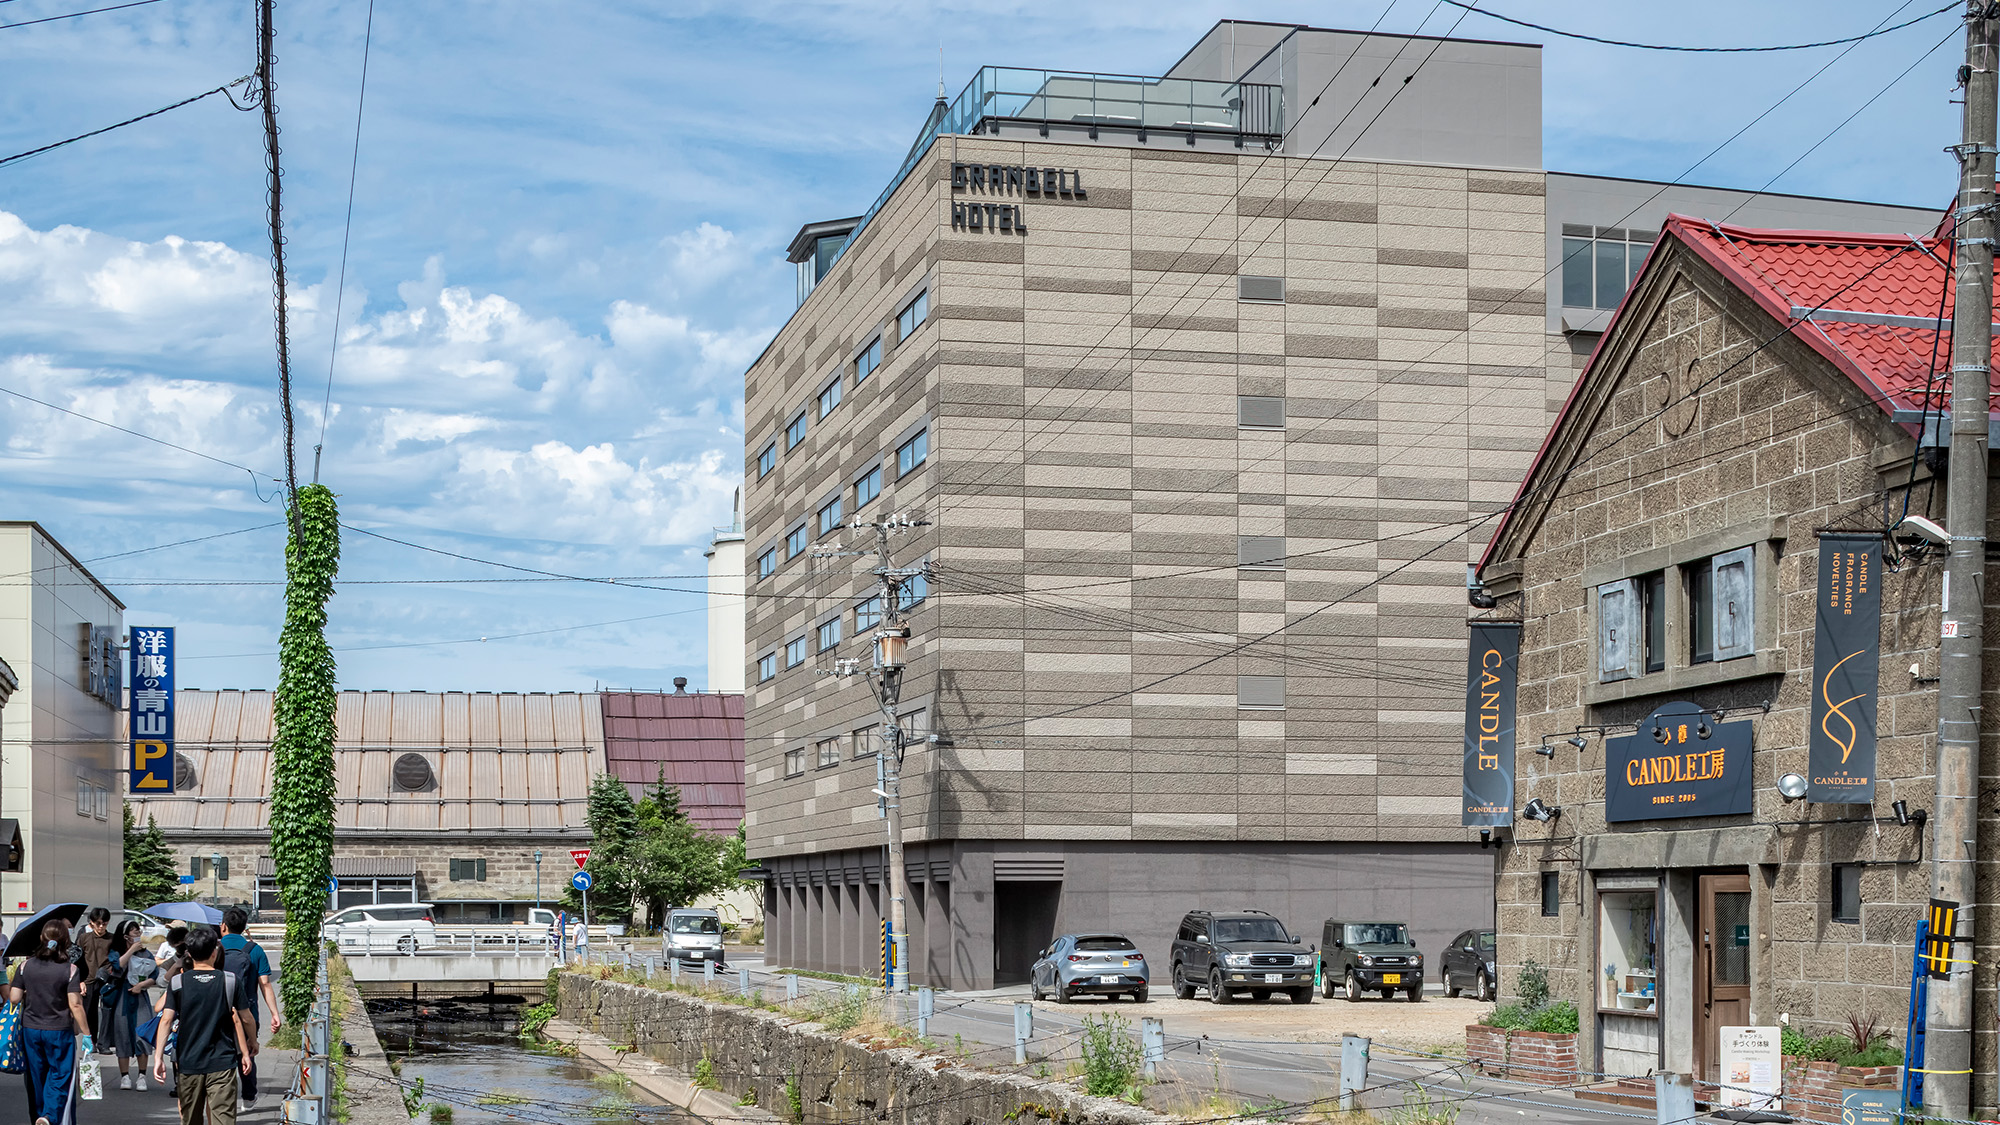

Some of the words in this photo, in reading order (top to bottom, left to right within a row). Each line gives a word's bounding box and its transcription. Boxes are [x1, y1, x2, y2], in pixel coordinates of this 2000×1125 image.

[951, 163, 1086, 195] GRANBELL
[951, 201, 1027, 231] HOTEL
[1830, 552, 1841, 608] NOVELTIES
[1843, 552, 1854, 616] FRAGRANCE
[1859, 552, 1868, 594] CANDLE
[135, 630, 169, 735] 洋服の青山
[1478, 649, 1502, 771] CANDLE
[135, 739, 168, 770] P
[1626, 747, 1726, 787] CANDLE工房
[1652, 795, 1675, 804] SINCE
